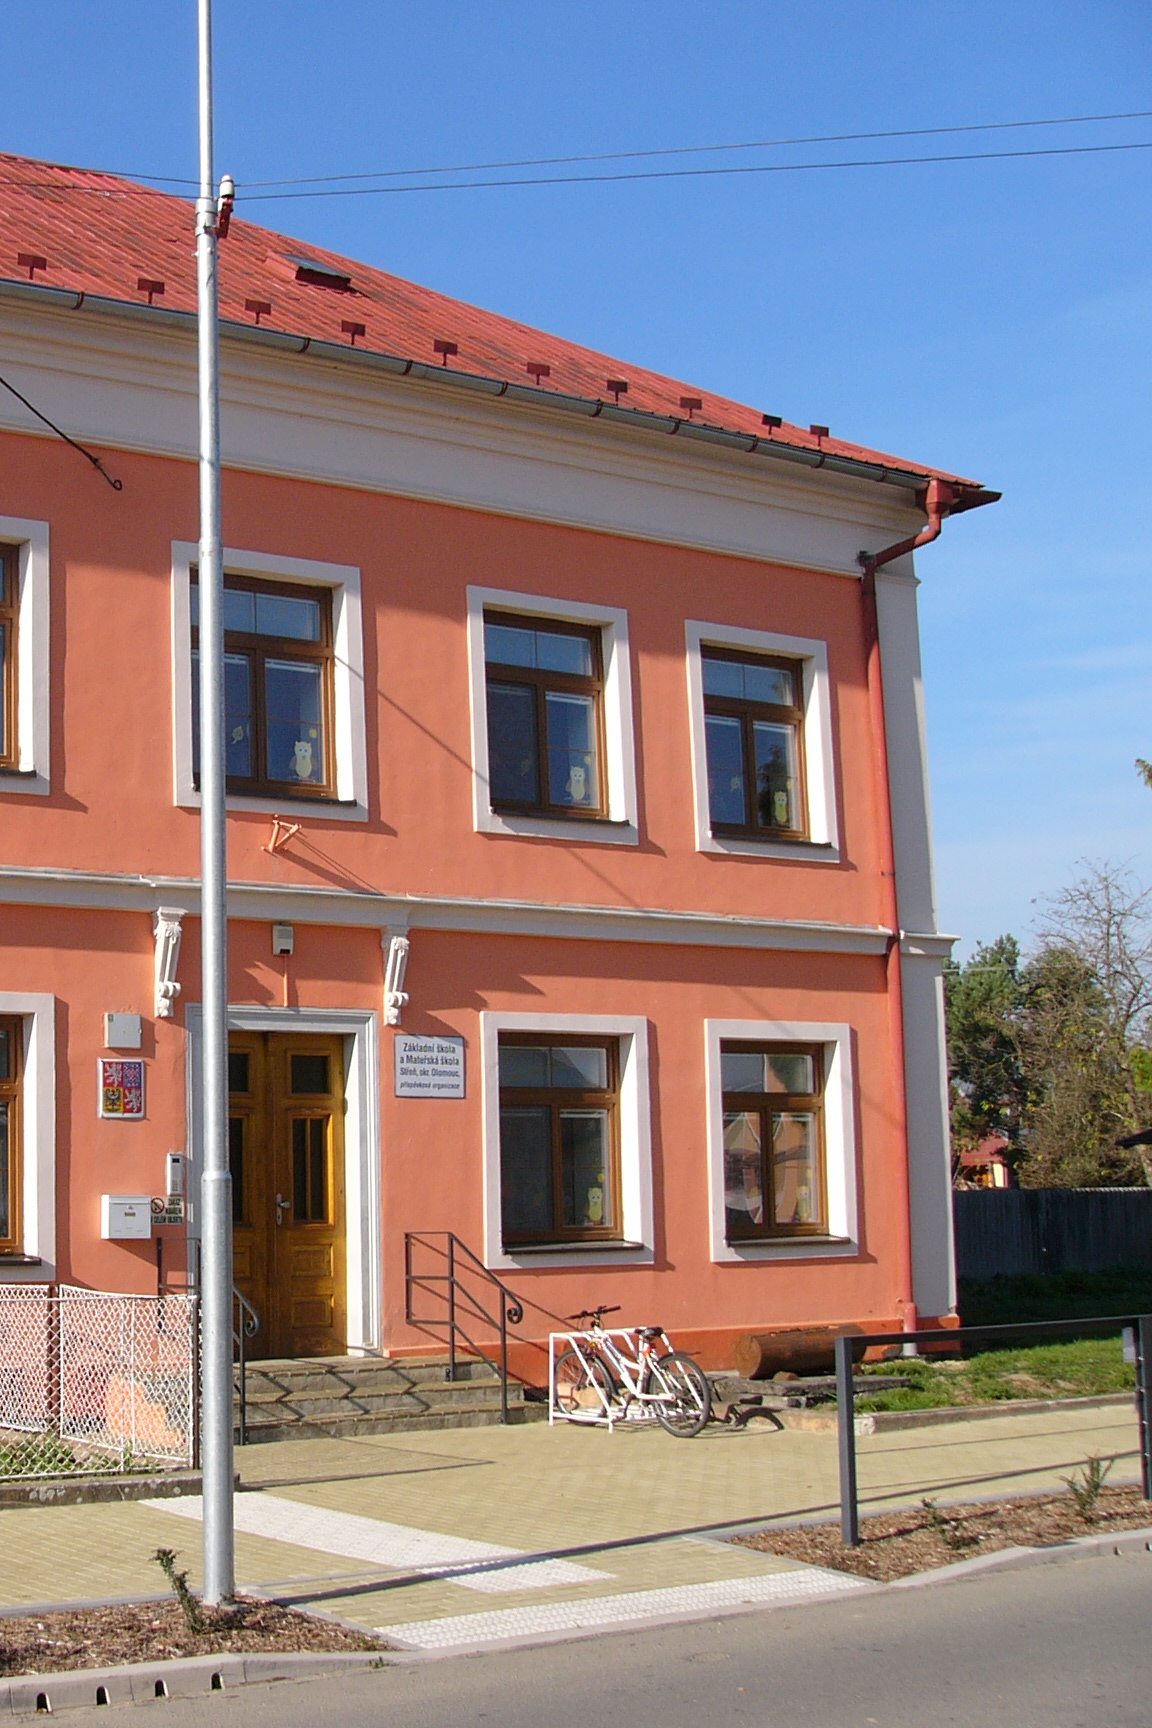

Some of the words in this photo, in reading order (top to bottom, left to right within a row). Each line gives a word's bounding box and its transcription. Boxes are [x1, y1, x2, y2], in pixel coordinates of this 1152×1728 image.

[403, 1042, 434, 1053] Základní
[436, 1043, 456, 1054] škola
[406, 1054, 439, 1065] Mateřská
[440, 1055, 459, 1065] škola
